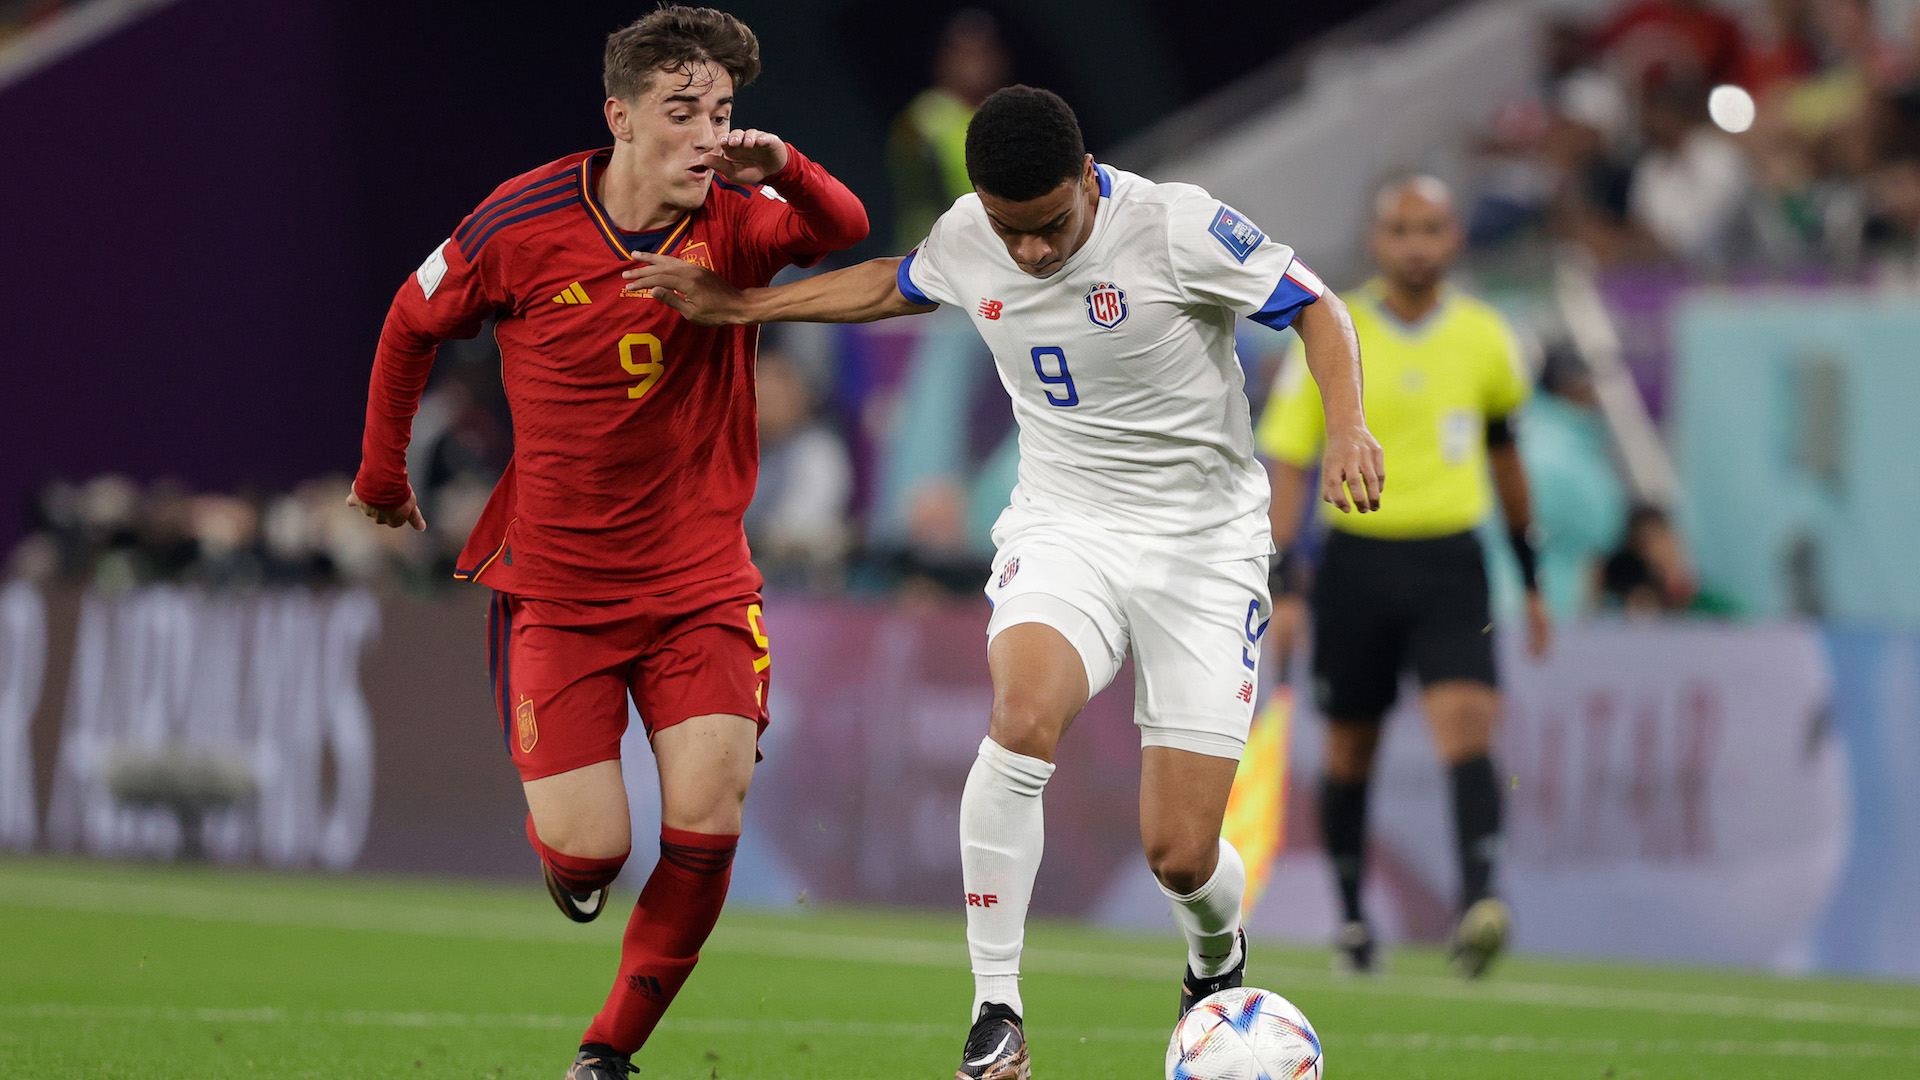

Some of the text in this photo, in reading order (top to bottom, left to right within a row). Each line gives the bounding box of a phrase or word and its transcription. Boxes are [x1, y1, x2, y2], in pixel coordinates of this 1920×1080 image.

[1093, 291, 1119, 322] CR
[617, 332, 665, 400] 9
[1030, 346, 1079, 407] 9
[964, 893, 998, 908] RF
